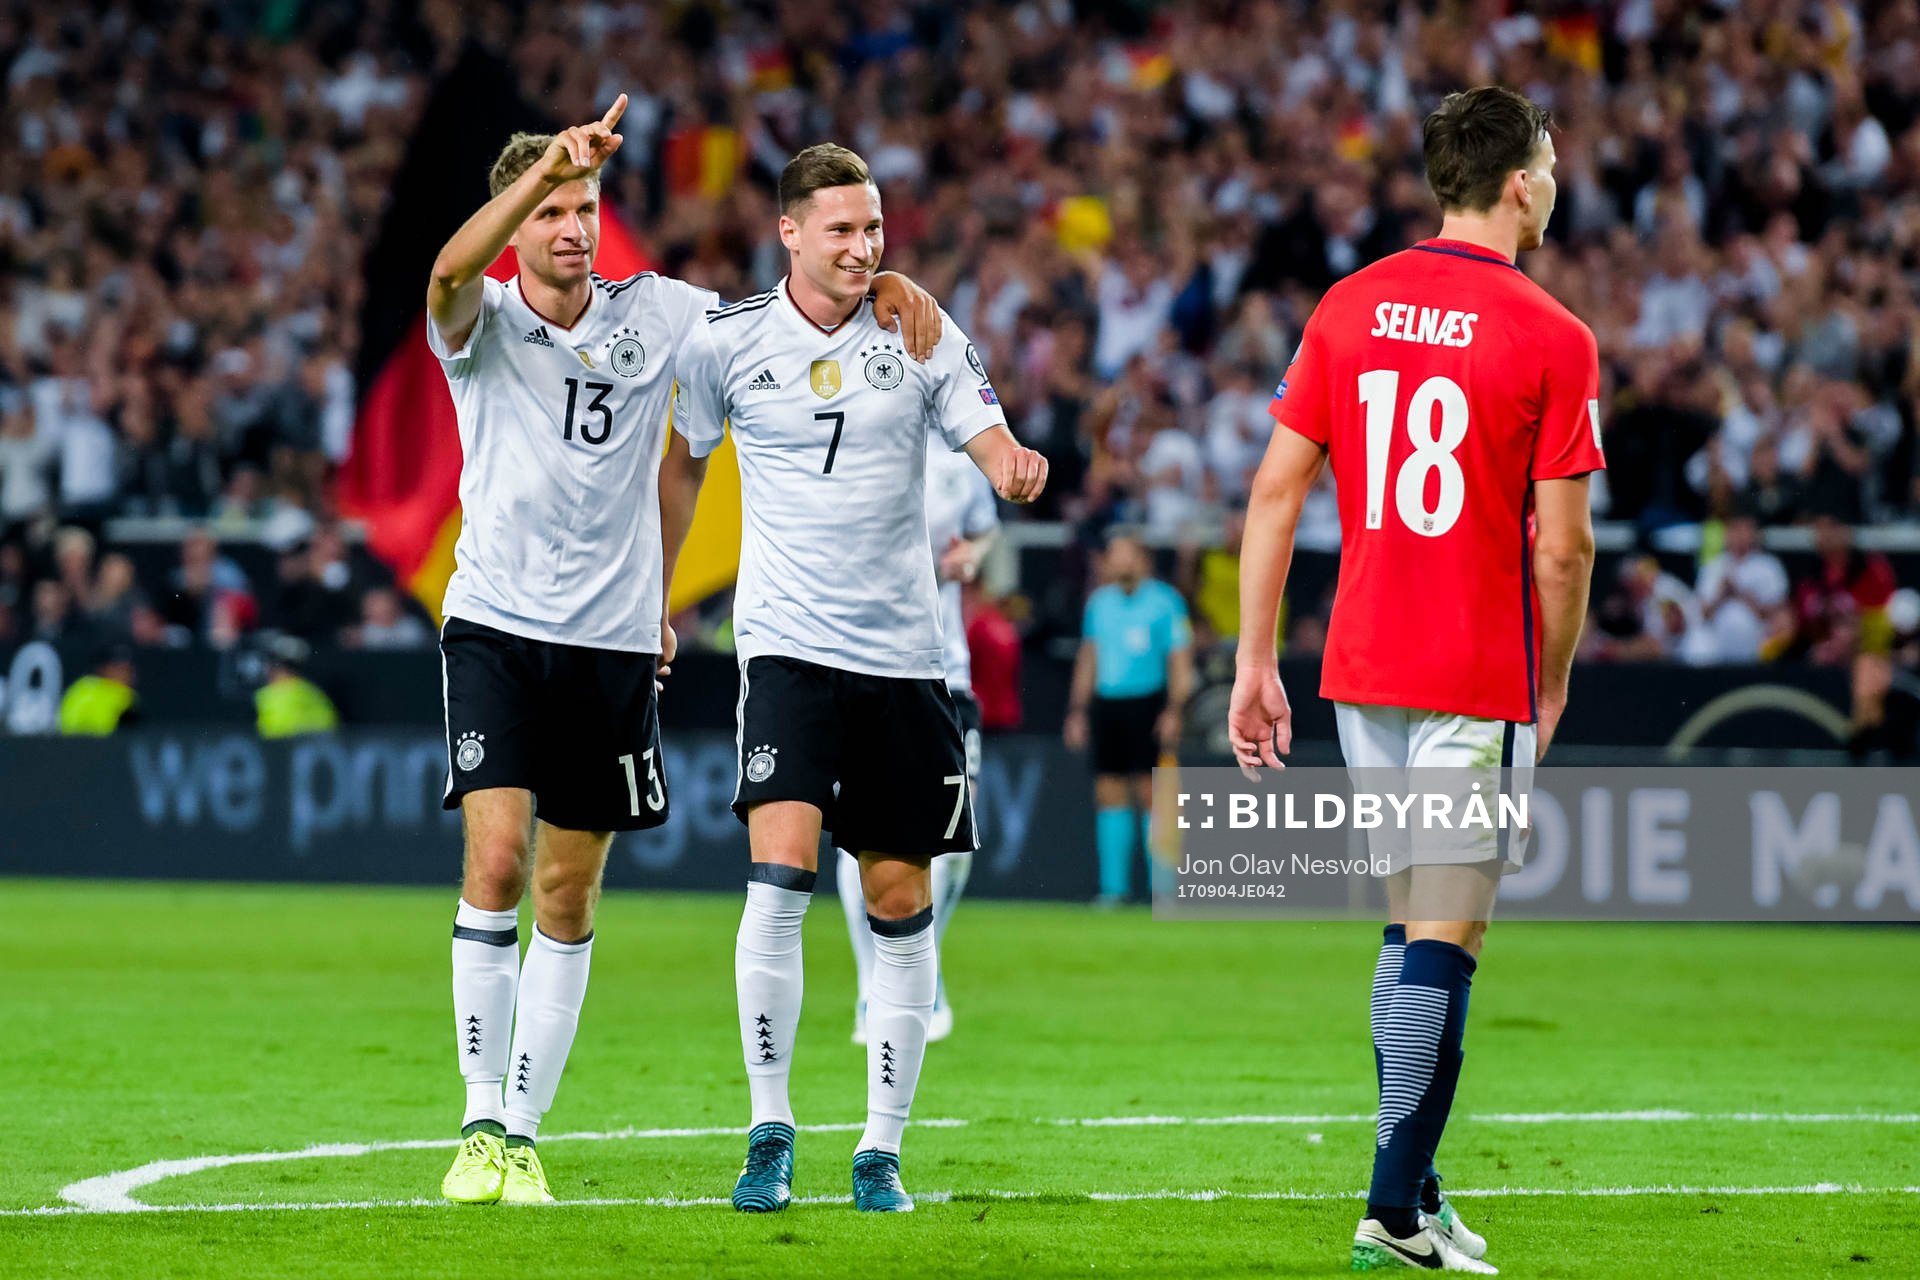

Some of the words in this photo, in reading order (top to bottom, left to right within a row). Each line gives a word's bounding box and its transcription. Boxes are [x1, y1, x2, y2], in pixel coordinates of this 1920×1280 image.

[524, 335, 554, 348] adidas
[1371, 301, 1479, 348] SELNÆS
[563, 377, 614, 445] 13
[748, 381, 781, 391] adidas
[814, 411, 845, 474] 7
[1358, 369, 1470, 538] 18
[130, 737, 265, 828] we
[618, 747, 666, 816] 13
[943, 774, 966, 839] 7
